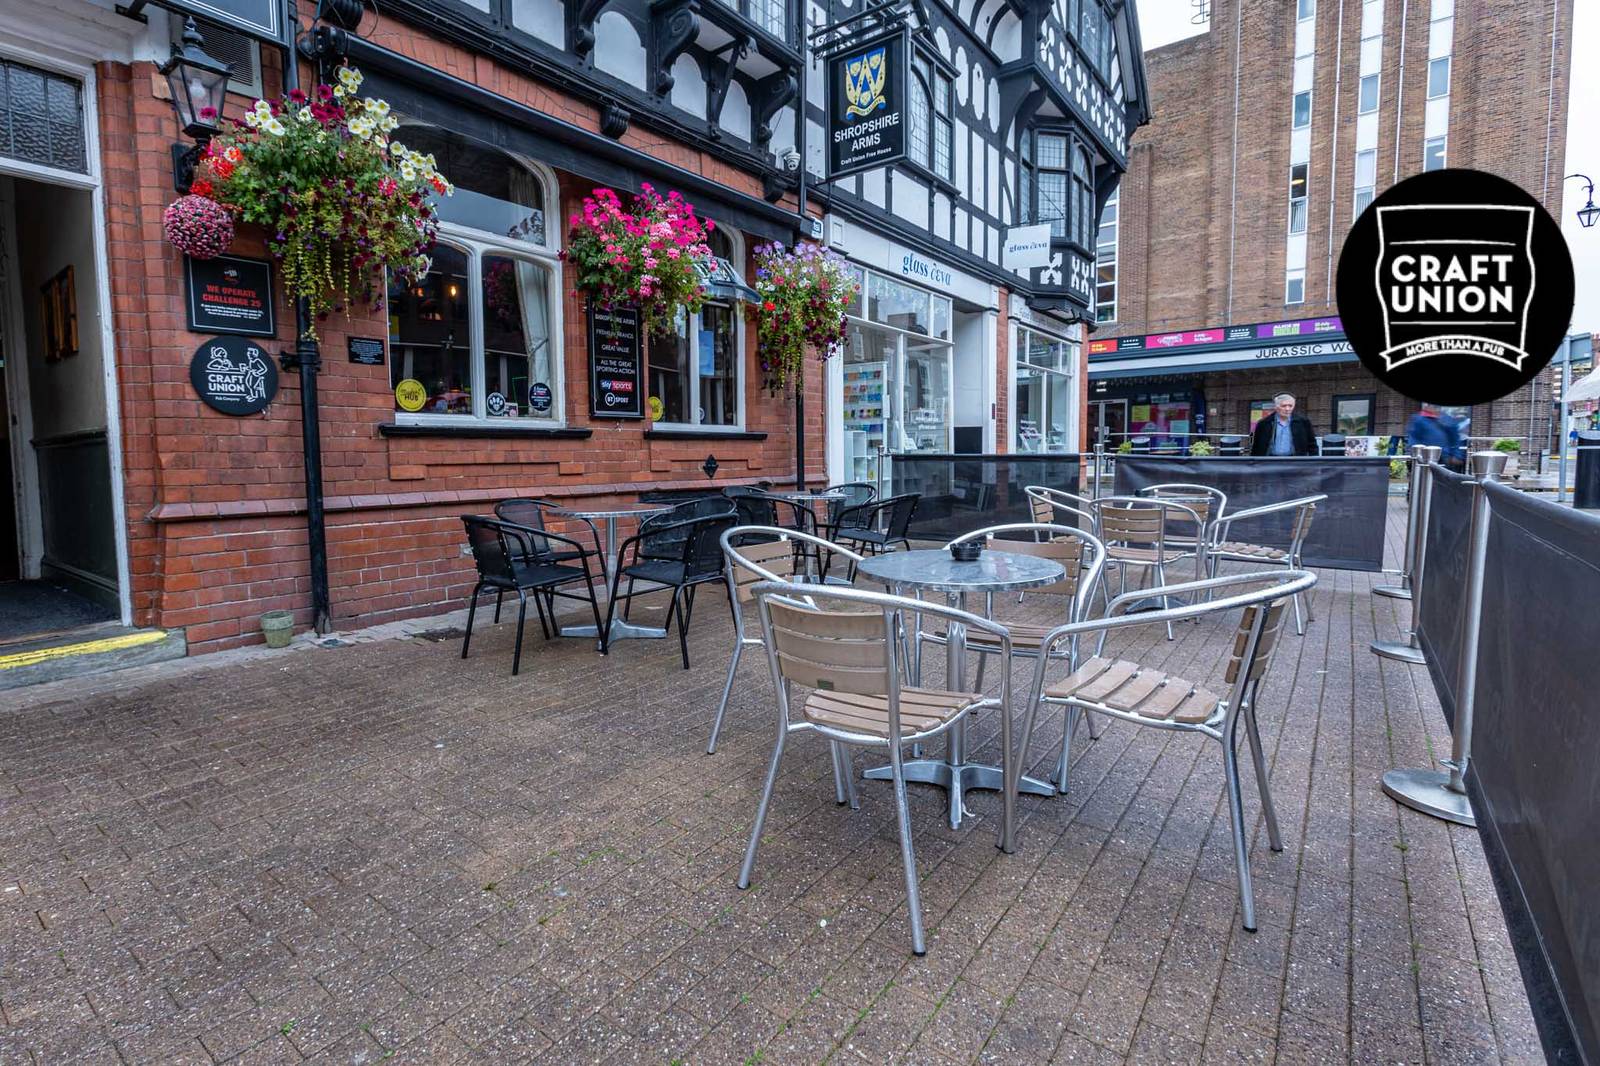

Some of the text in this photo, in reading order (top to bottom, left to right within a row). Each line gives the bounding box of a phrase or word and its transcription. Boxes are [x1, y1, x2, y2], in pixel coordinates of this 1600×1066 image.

[834, 112, 899, 142] SHROPSHIRE
[852, 133, 881, 151] ARMS
[877, 147, 892, 155] House
[902, 253, 929, 277] glass
[207, 284, 256, 298] WE OPERATE
[202, 294, 249, 306] CHALLENGE
[1255, 344, 1322, 358] JURASSIC
[596, 365, 618, 373] SPORTING
[208, 374, 244, 383] CRAFT
[208, 383, 245, 392] UNION
[601, 381, 633, 391] sky sports
